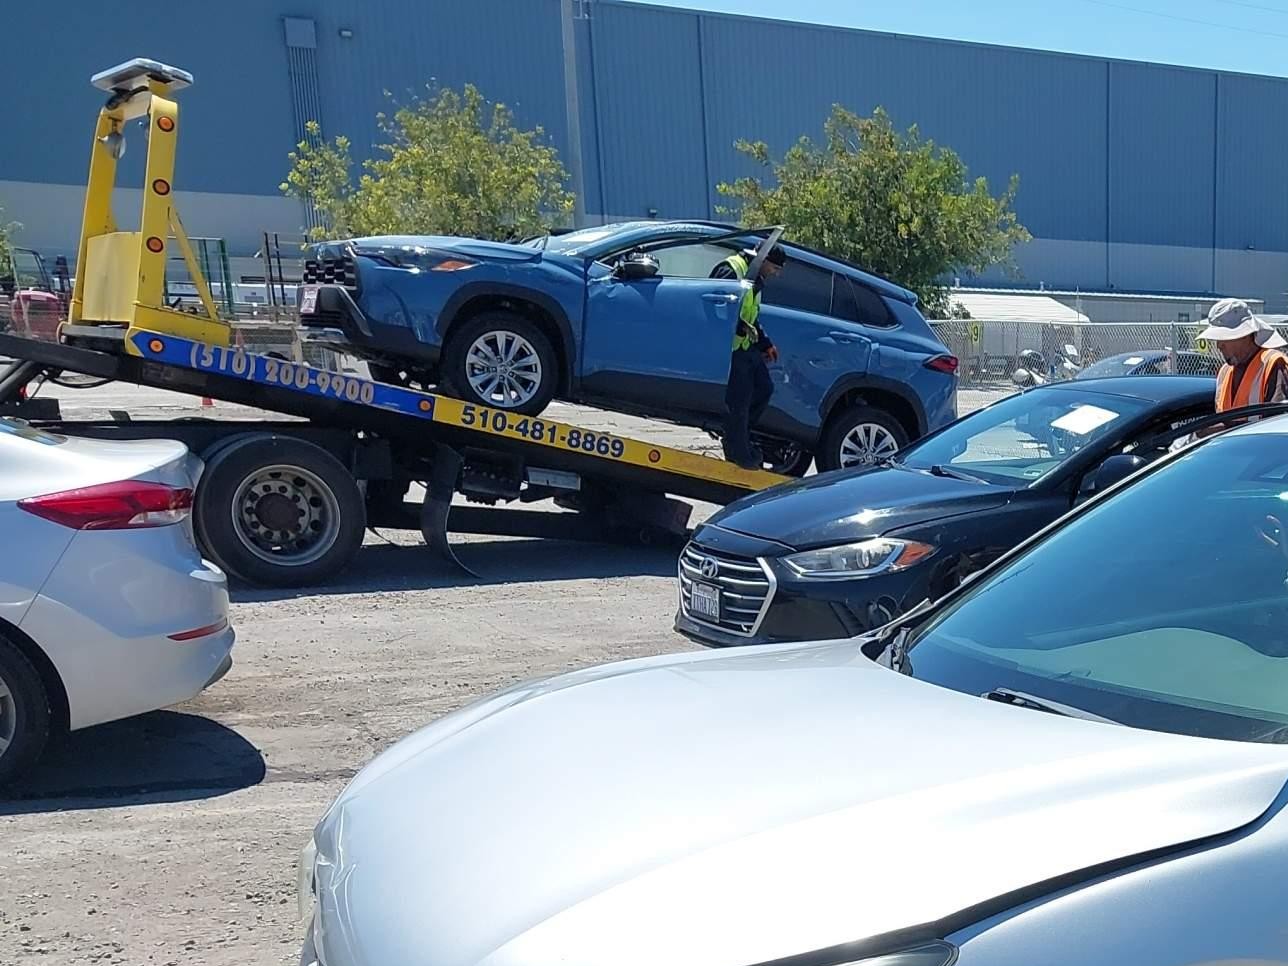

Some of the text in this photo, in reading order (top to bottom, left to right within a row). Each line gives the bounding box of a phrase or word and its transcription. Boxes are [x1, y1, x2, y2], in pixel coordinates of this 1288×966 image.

[191, 343, 375, 404] (510) 200-9900
[461, 402, 624, 458] 510-481-8869
